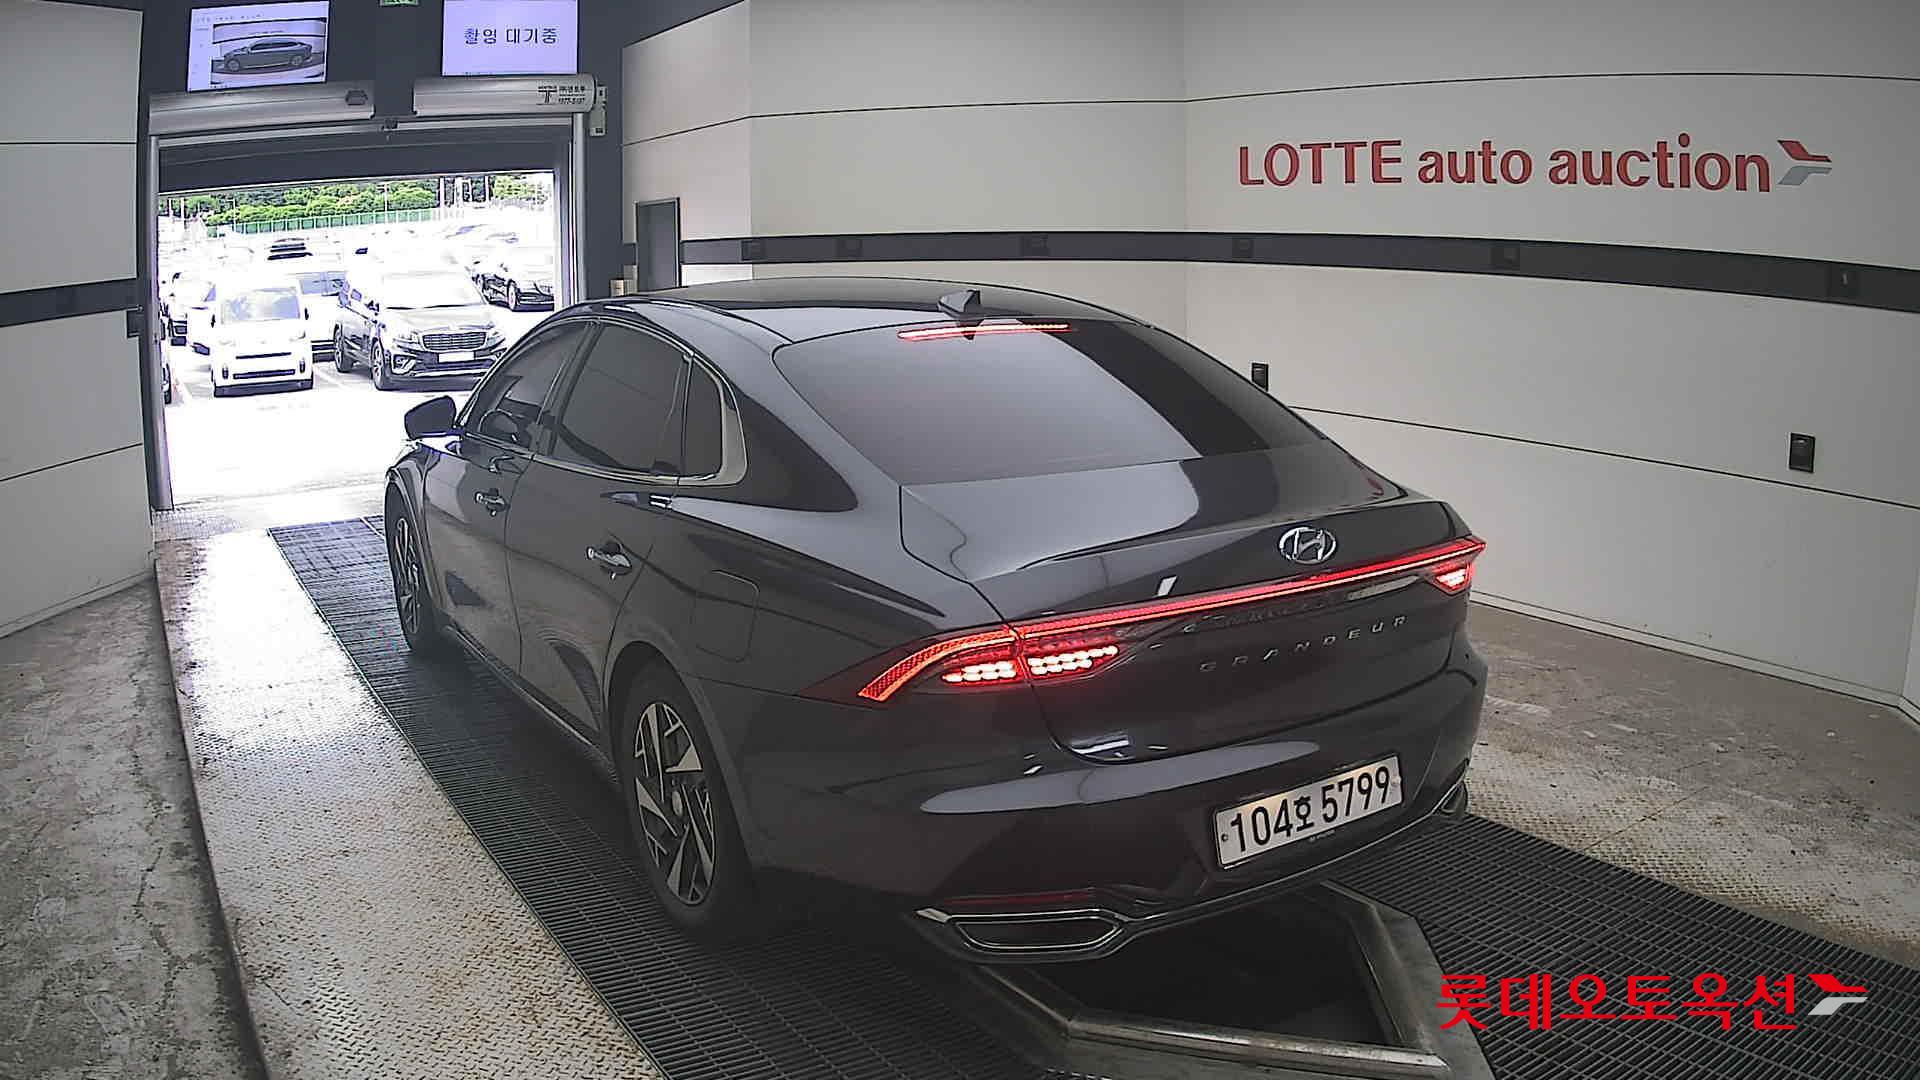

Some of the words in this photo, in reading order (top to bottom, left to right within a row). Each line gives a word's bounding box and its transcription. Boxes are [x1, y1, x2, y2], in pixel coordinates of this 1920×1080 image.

[506, 28, 557, 45] 대기중
[1239, 140, 1402, 186] LOTTE
[1418, 140, 1532, 185] auto
[1548, 133, 1771, 192] auction
[1199, 615, 1407, 672] GRANDEUR
